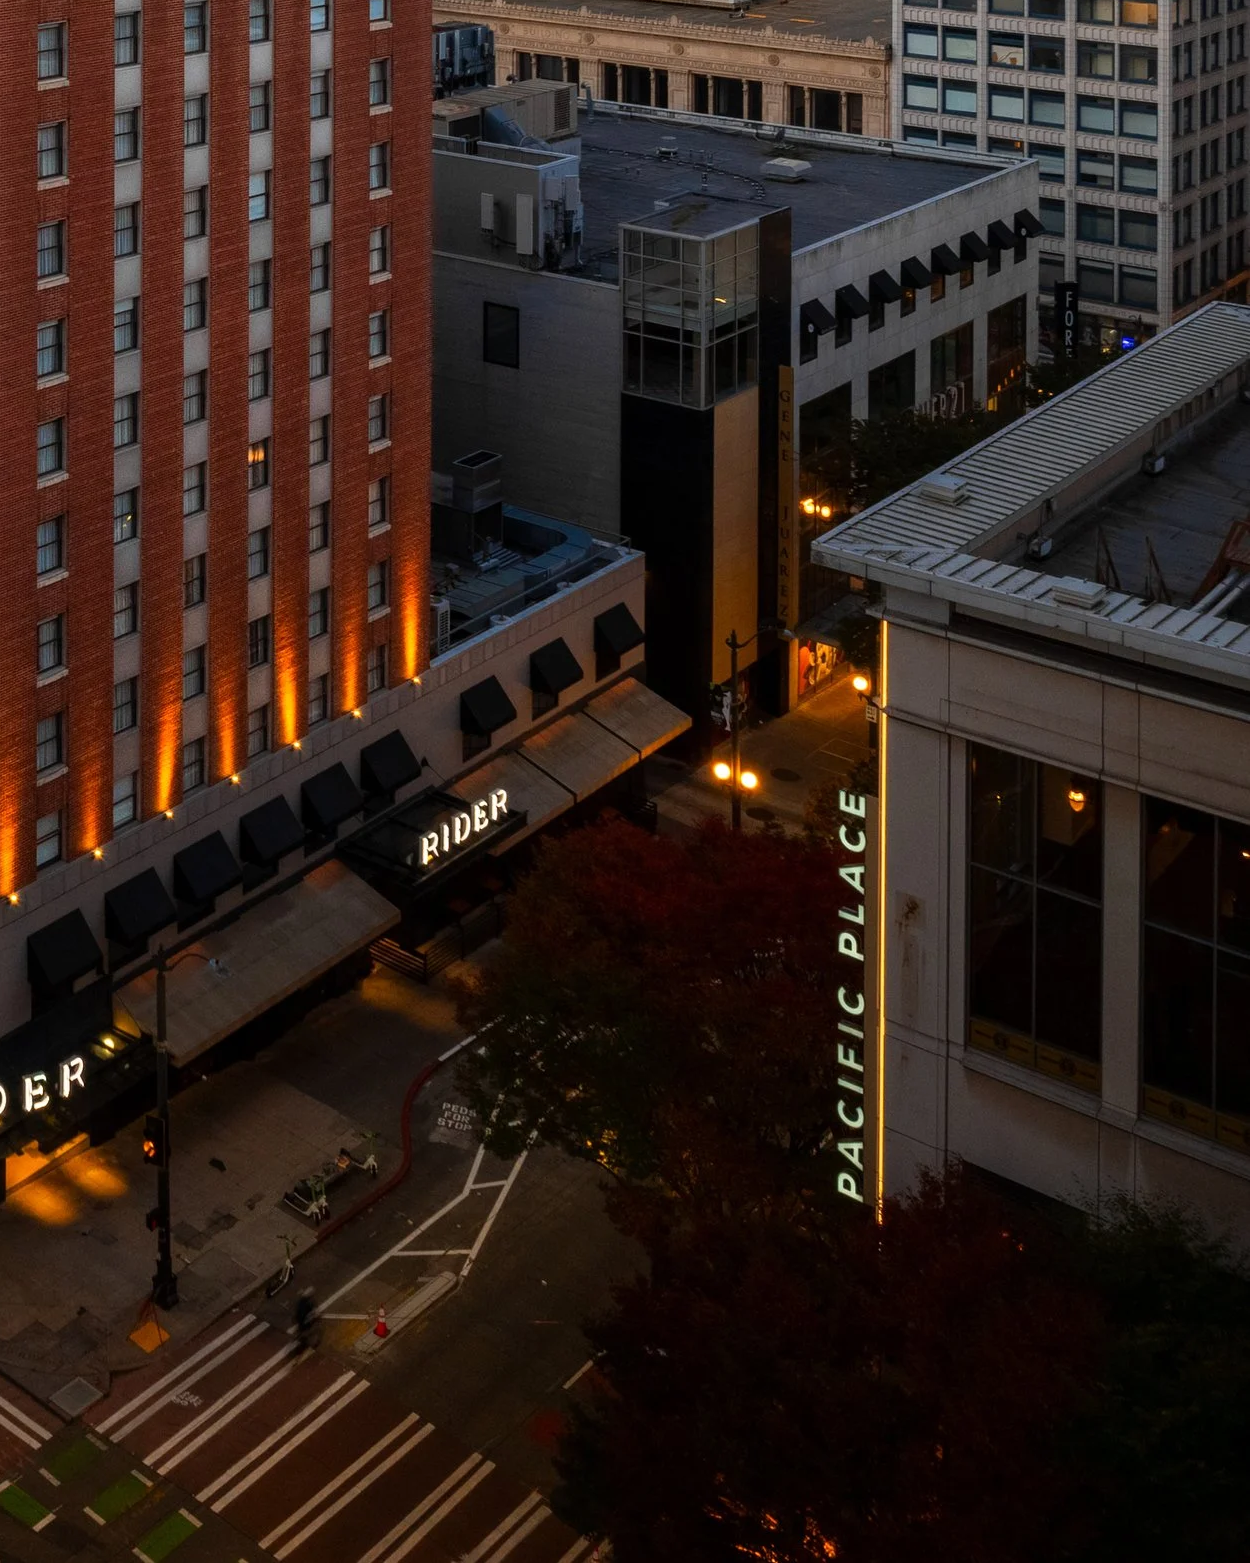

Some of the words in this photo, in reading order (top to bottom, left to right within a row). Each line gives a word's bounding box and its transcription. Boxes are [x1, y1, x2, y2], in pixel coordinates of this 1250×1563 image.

[779, 390, 791, 462] GENE
[779, 505, 790, 617] JUAREZ
[418, 788, 509, 866] RIDER
[838, 790, 867, 962] PLACE
[437, 1118, 472, 1131] STOP
[444, 1111, 470, 1124] FOR
[837, 986, 866, 1204] PACIFIC
